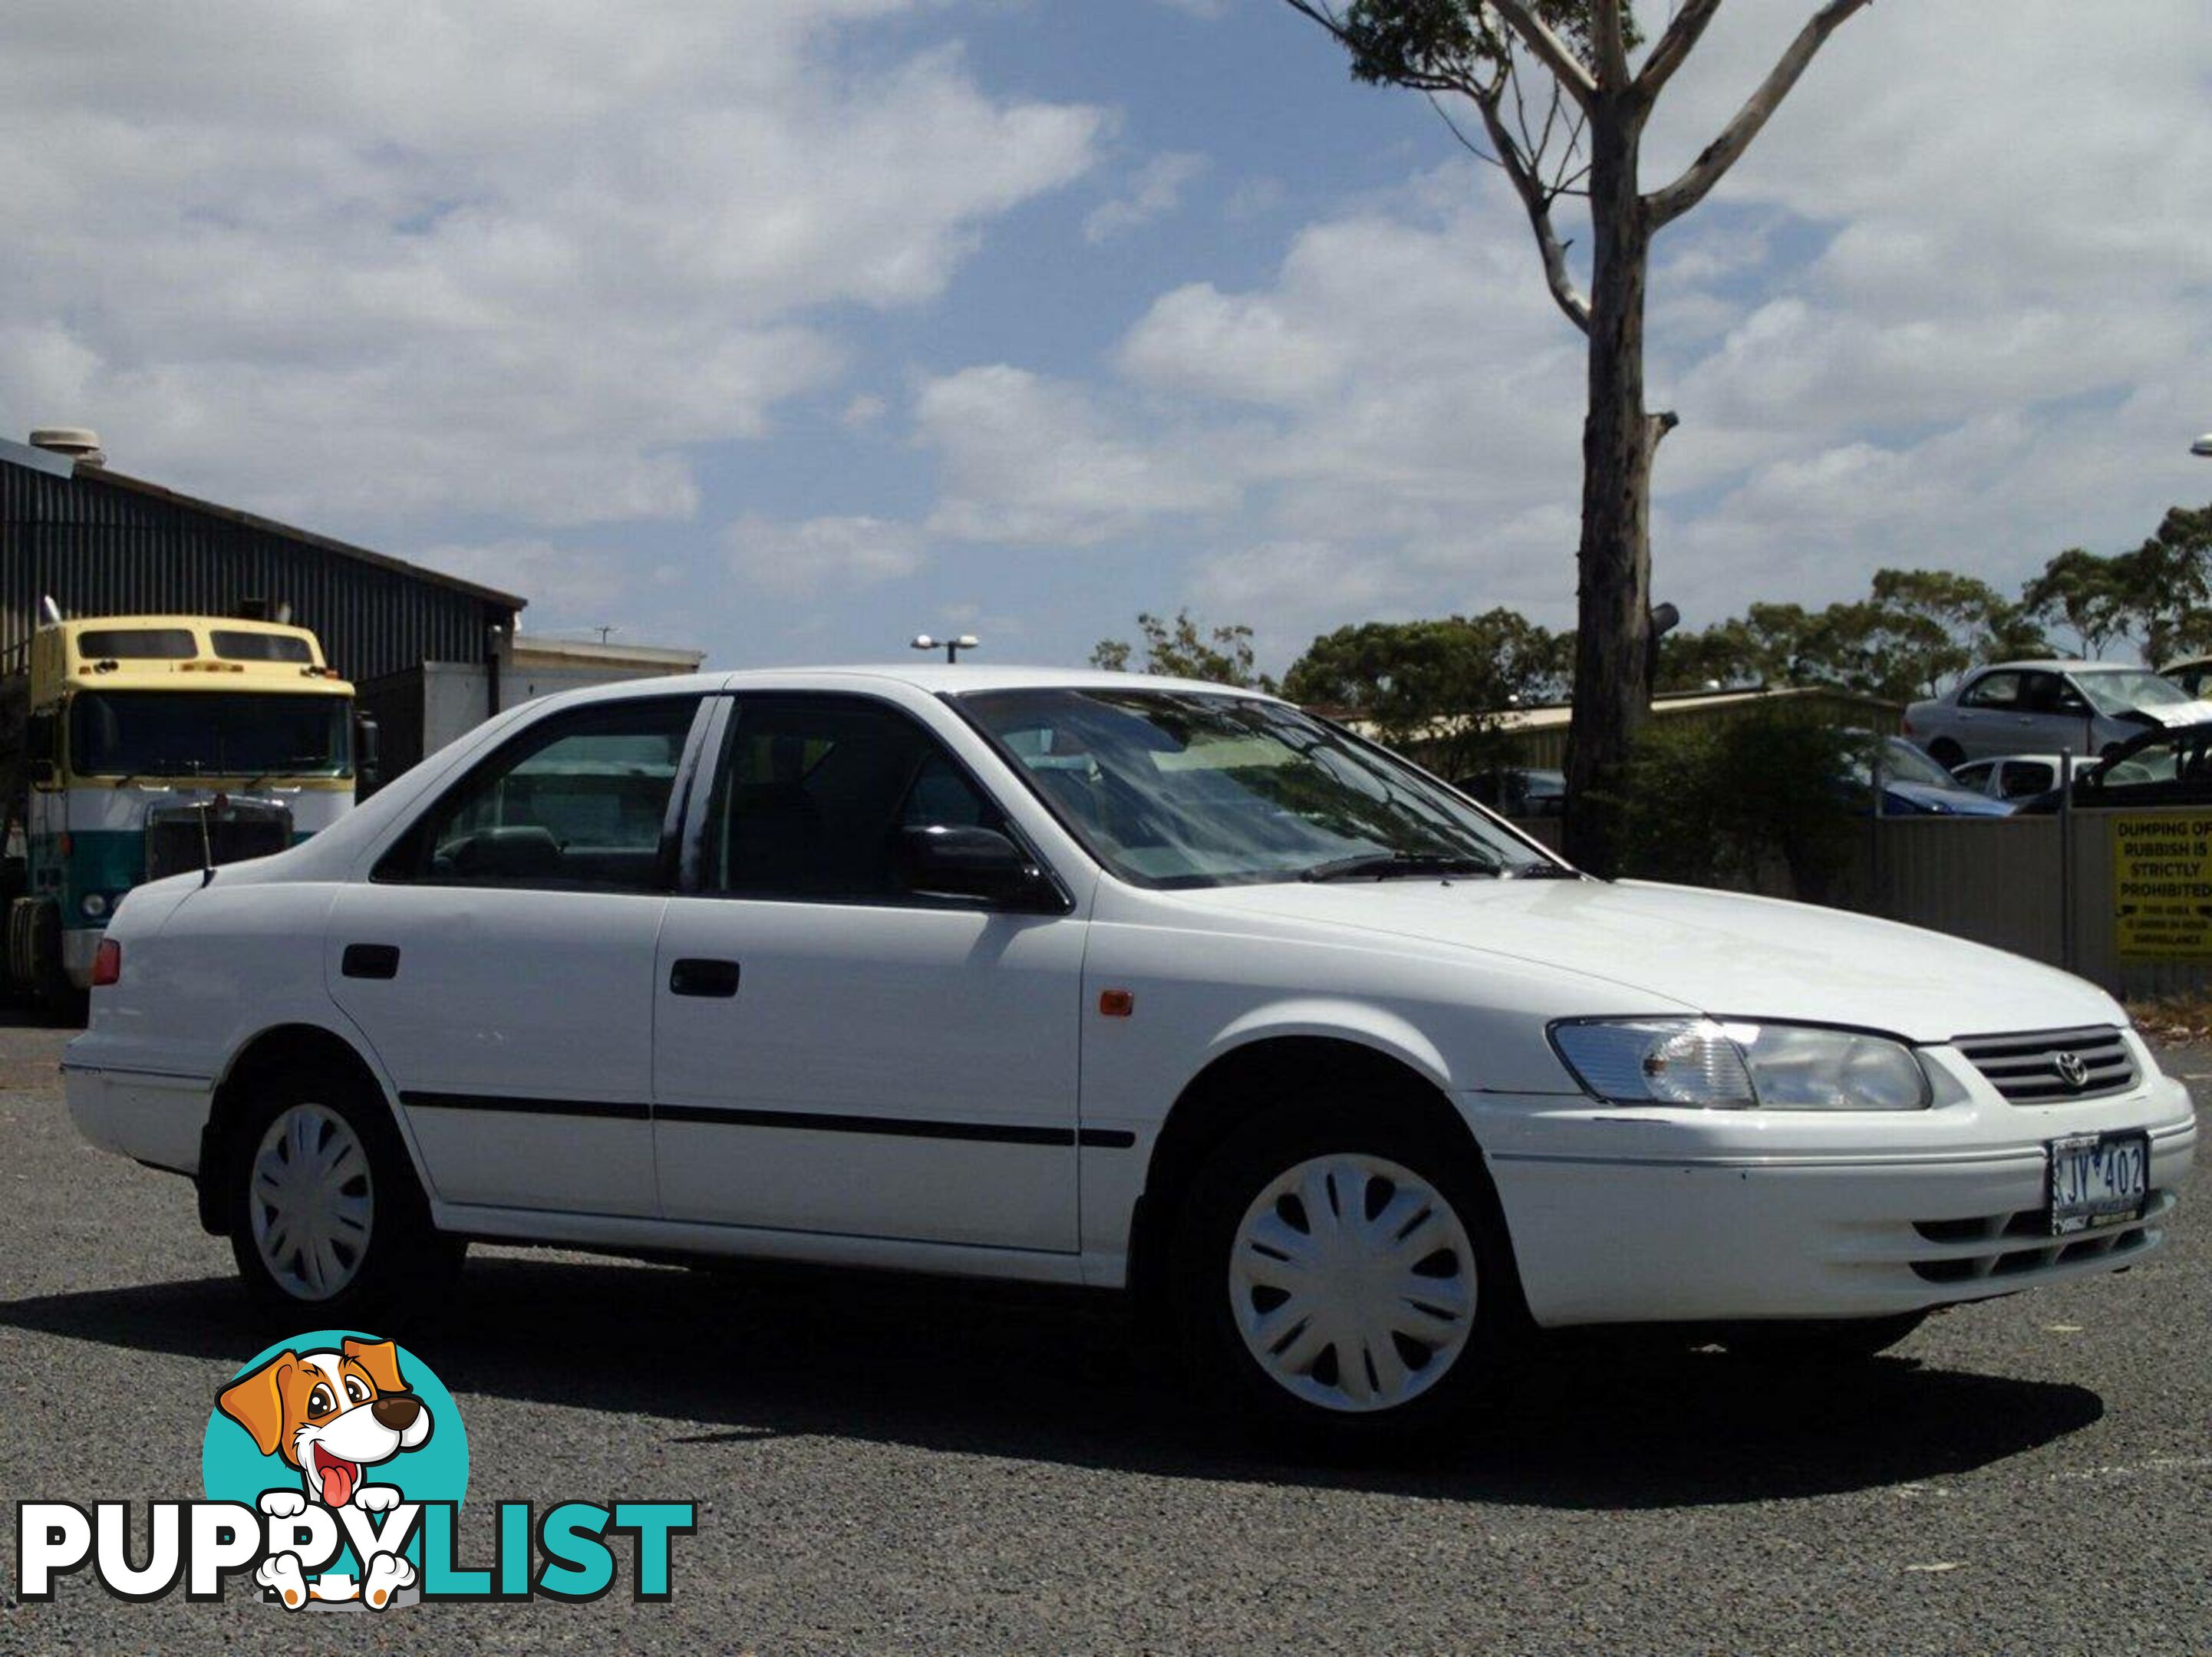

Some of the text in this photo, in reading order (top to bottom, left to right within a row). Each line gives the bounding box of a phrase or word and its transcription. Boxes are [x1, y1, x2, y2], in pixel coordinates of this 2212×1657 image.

[2118, 822, 2188, 837] DUMPING
[2124, 841, 2207, 857] RUBBISH IS
[2131, 861, 2200, 877] STRICTLY
[2120, 882, 2212, 898] PROHIBITED
